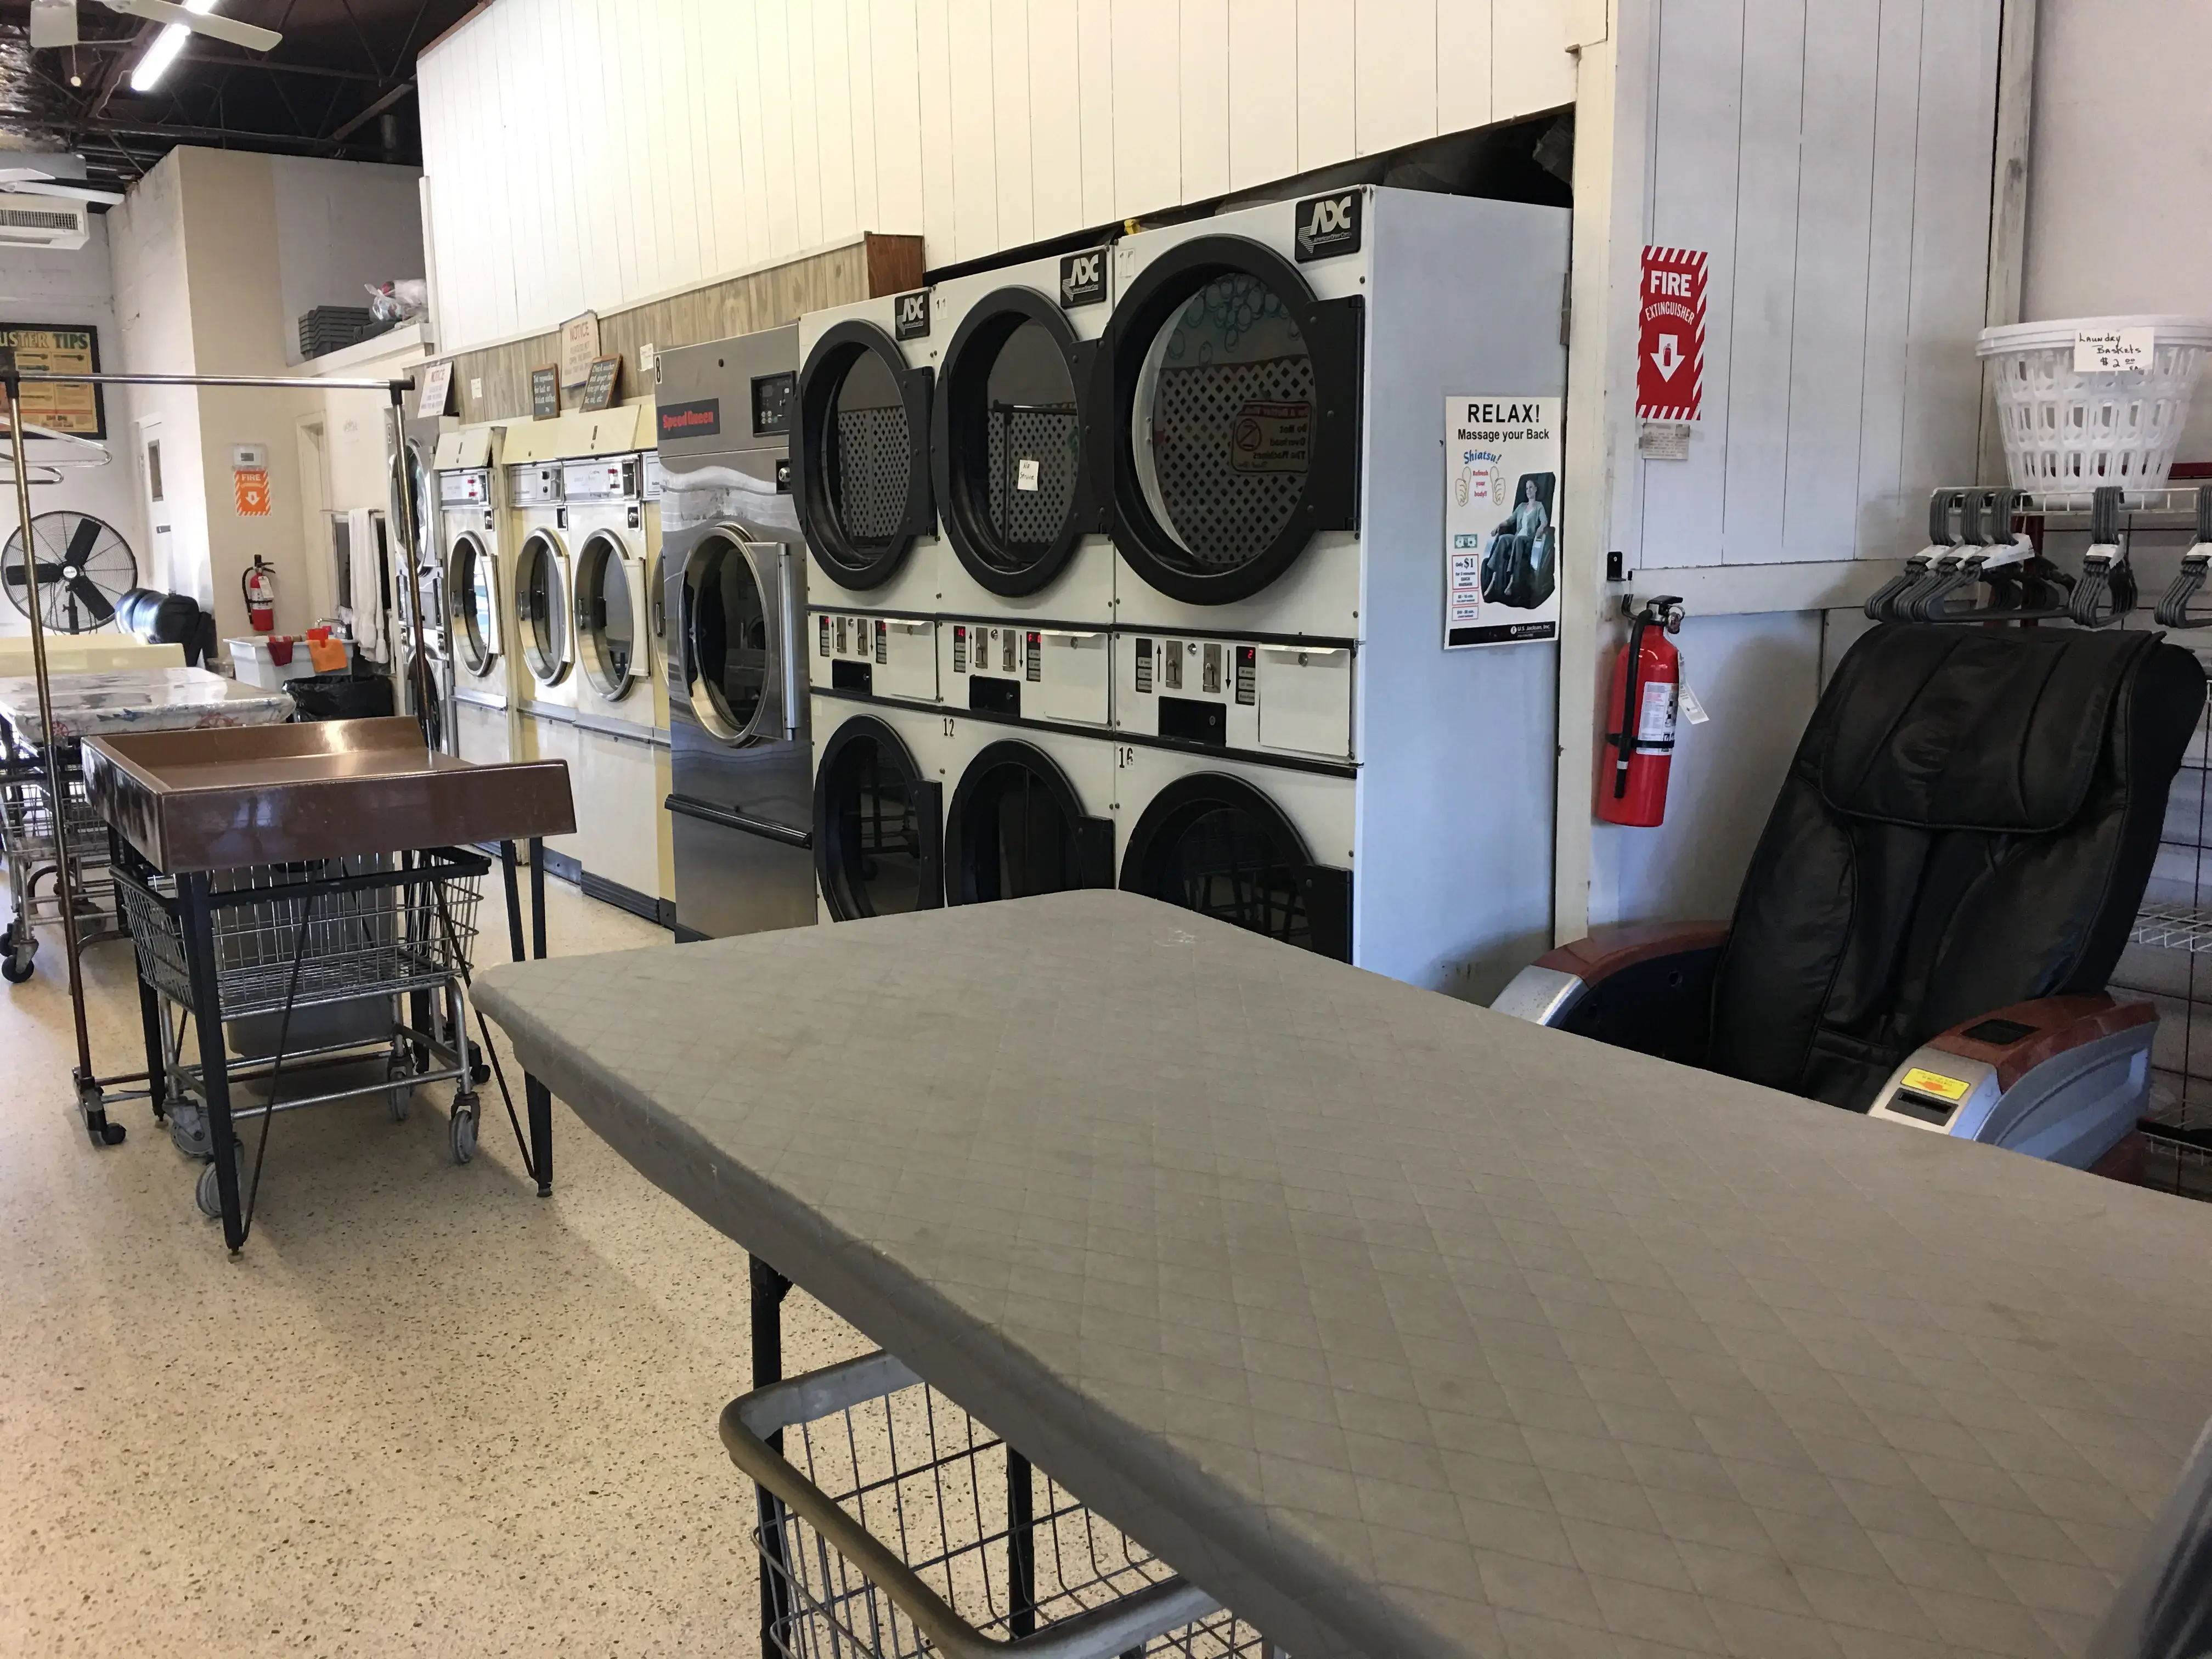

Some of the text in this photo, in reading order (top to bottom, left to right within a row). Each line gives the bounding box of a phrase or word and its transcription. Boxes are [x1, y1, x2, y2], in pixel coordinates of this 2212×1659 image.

[1310, 195, 1352, 235] ADC
[1070, 254, 1099, 287] ADC
[1650, 270, 1692, 297] FIRE
[902, 295, 924, 322] ADC
[1645, 301, 1695, 325] EXTINGUISHER
[53, 333, 89, 349] TIPS
[569, 321, 590, 342] NOTICE
[656, 357, 661, 383] 8
[662, 410, 713, 432] Speed Queen
[1468, 404, 1539, 423] RELAX!
[1458, 428, 1550, 443] Massage your Back
[1463, 449, 1502, 464] Shiatsu!
[1464, 557, 1474, 570] $1
[943, 717, 955, 737] 12
